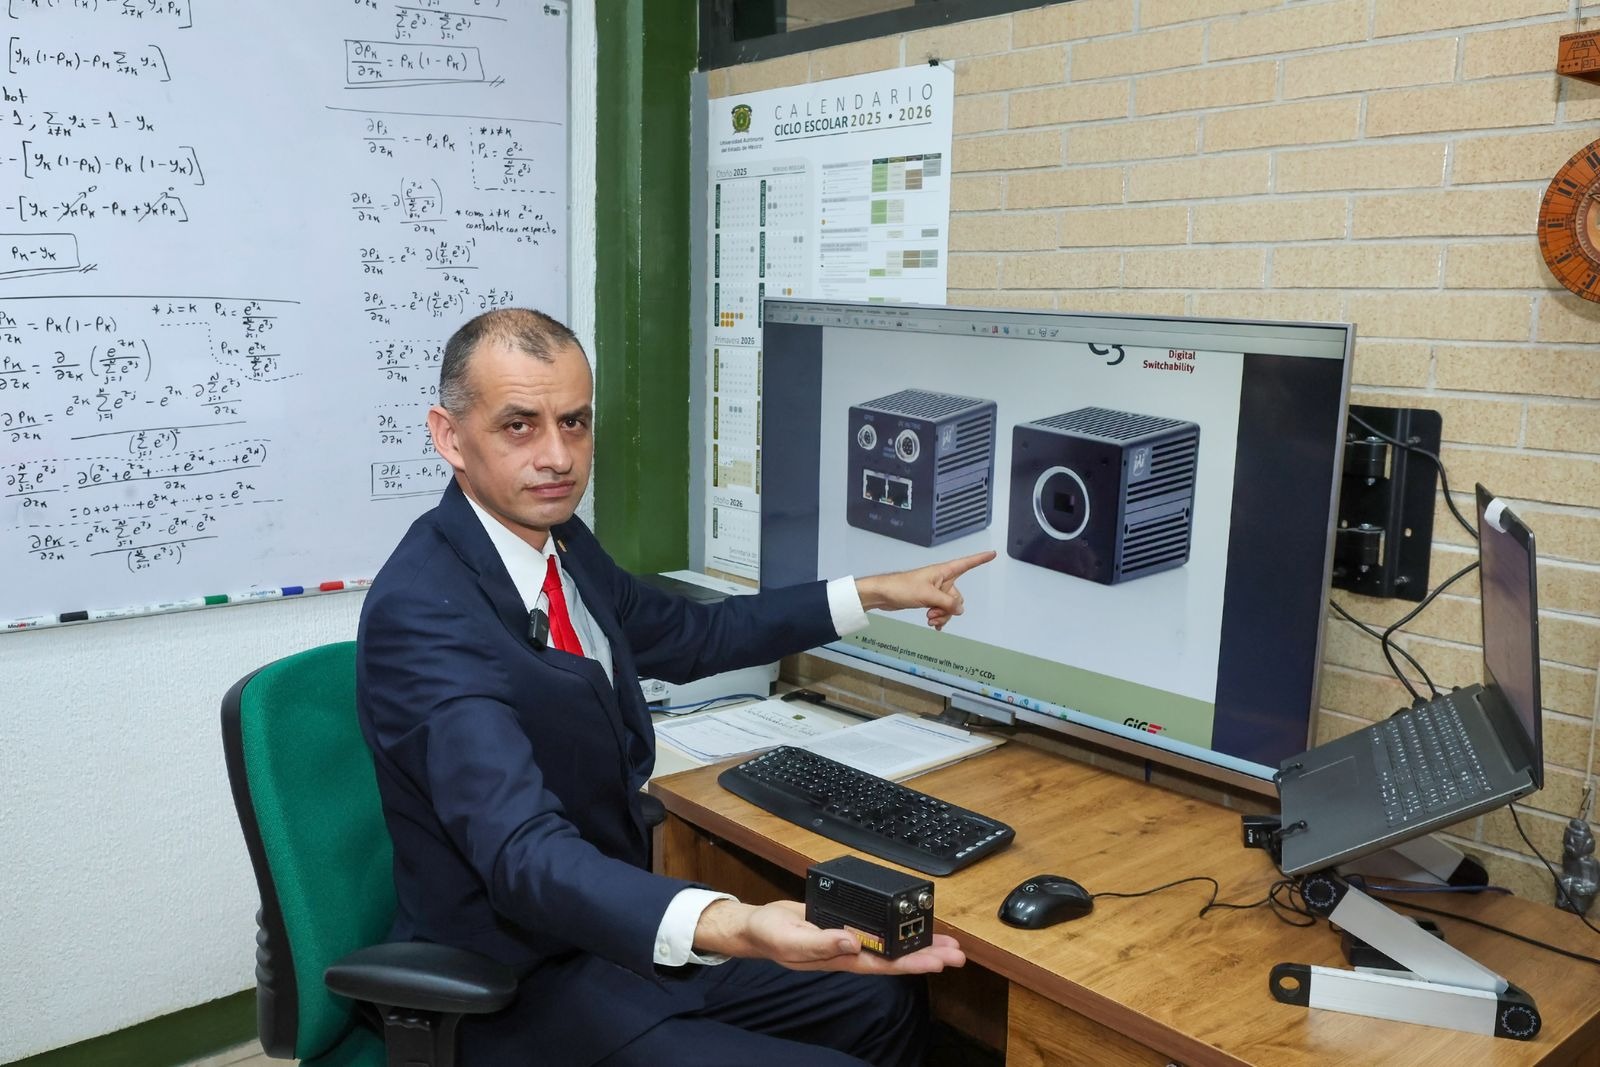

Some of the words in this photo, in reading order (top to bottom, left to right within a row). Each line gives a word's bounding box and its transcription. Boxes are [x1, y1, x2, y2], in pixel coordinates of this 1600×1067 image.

[775, 83, 933, 120] CALENDARIO
[774, 121, 801, 137] CICLO
[804, 115, 848, 133] ESCOLAR
[850, 111, 881, 127] 2025
[899, 104, 932, 121] 2026
[733, 167, 747, 176] 2025
[1168, 350, 1196, 360] Digital
[1143, 360, 1195, 374] Switchability
[899, 649, 917, 659] prism
[917, 653, 938, 664] camera
[939, 659, 953, 668] with
[979, 669, 996, 680] CCDs
